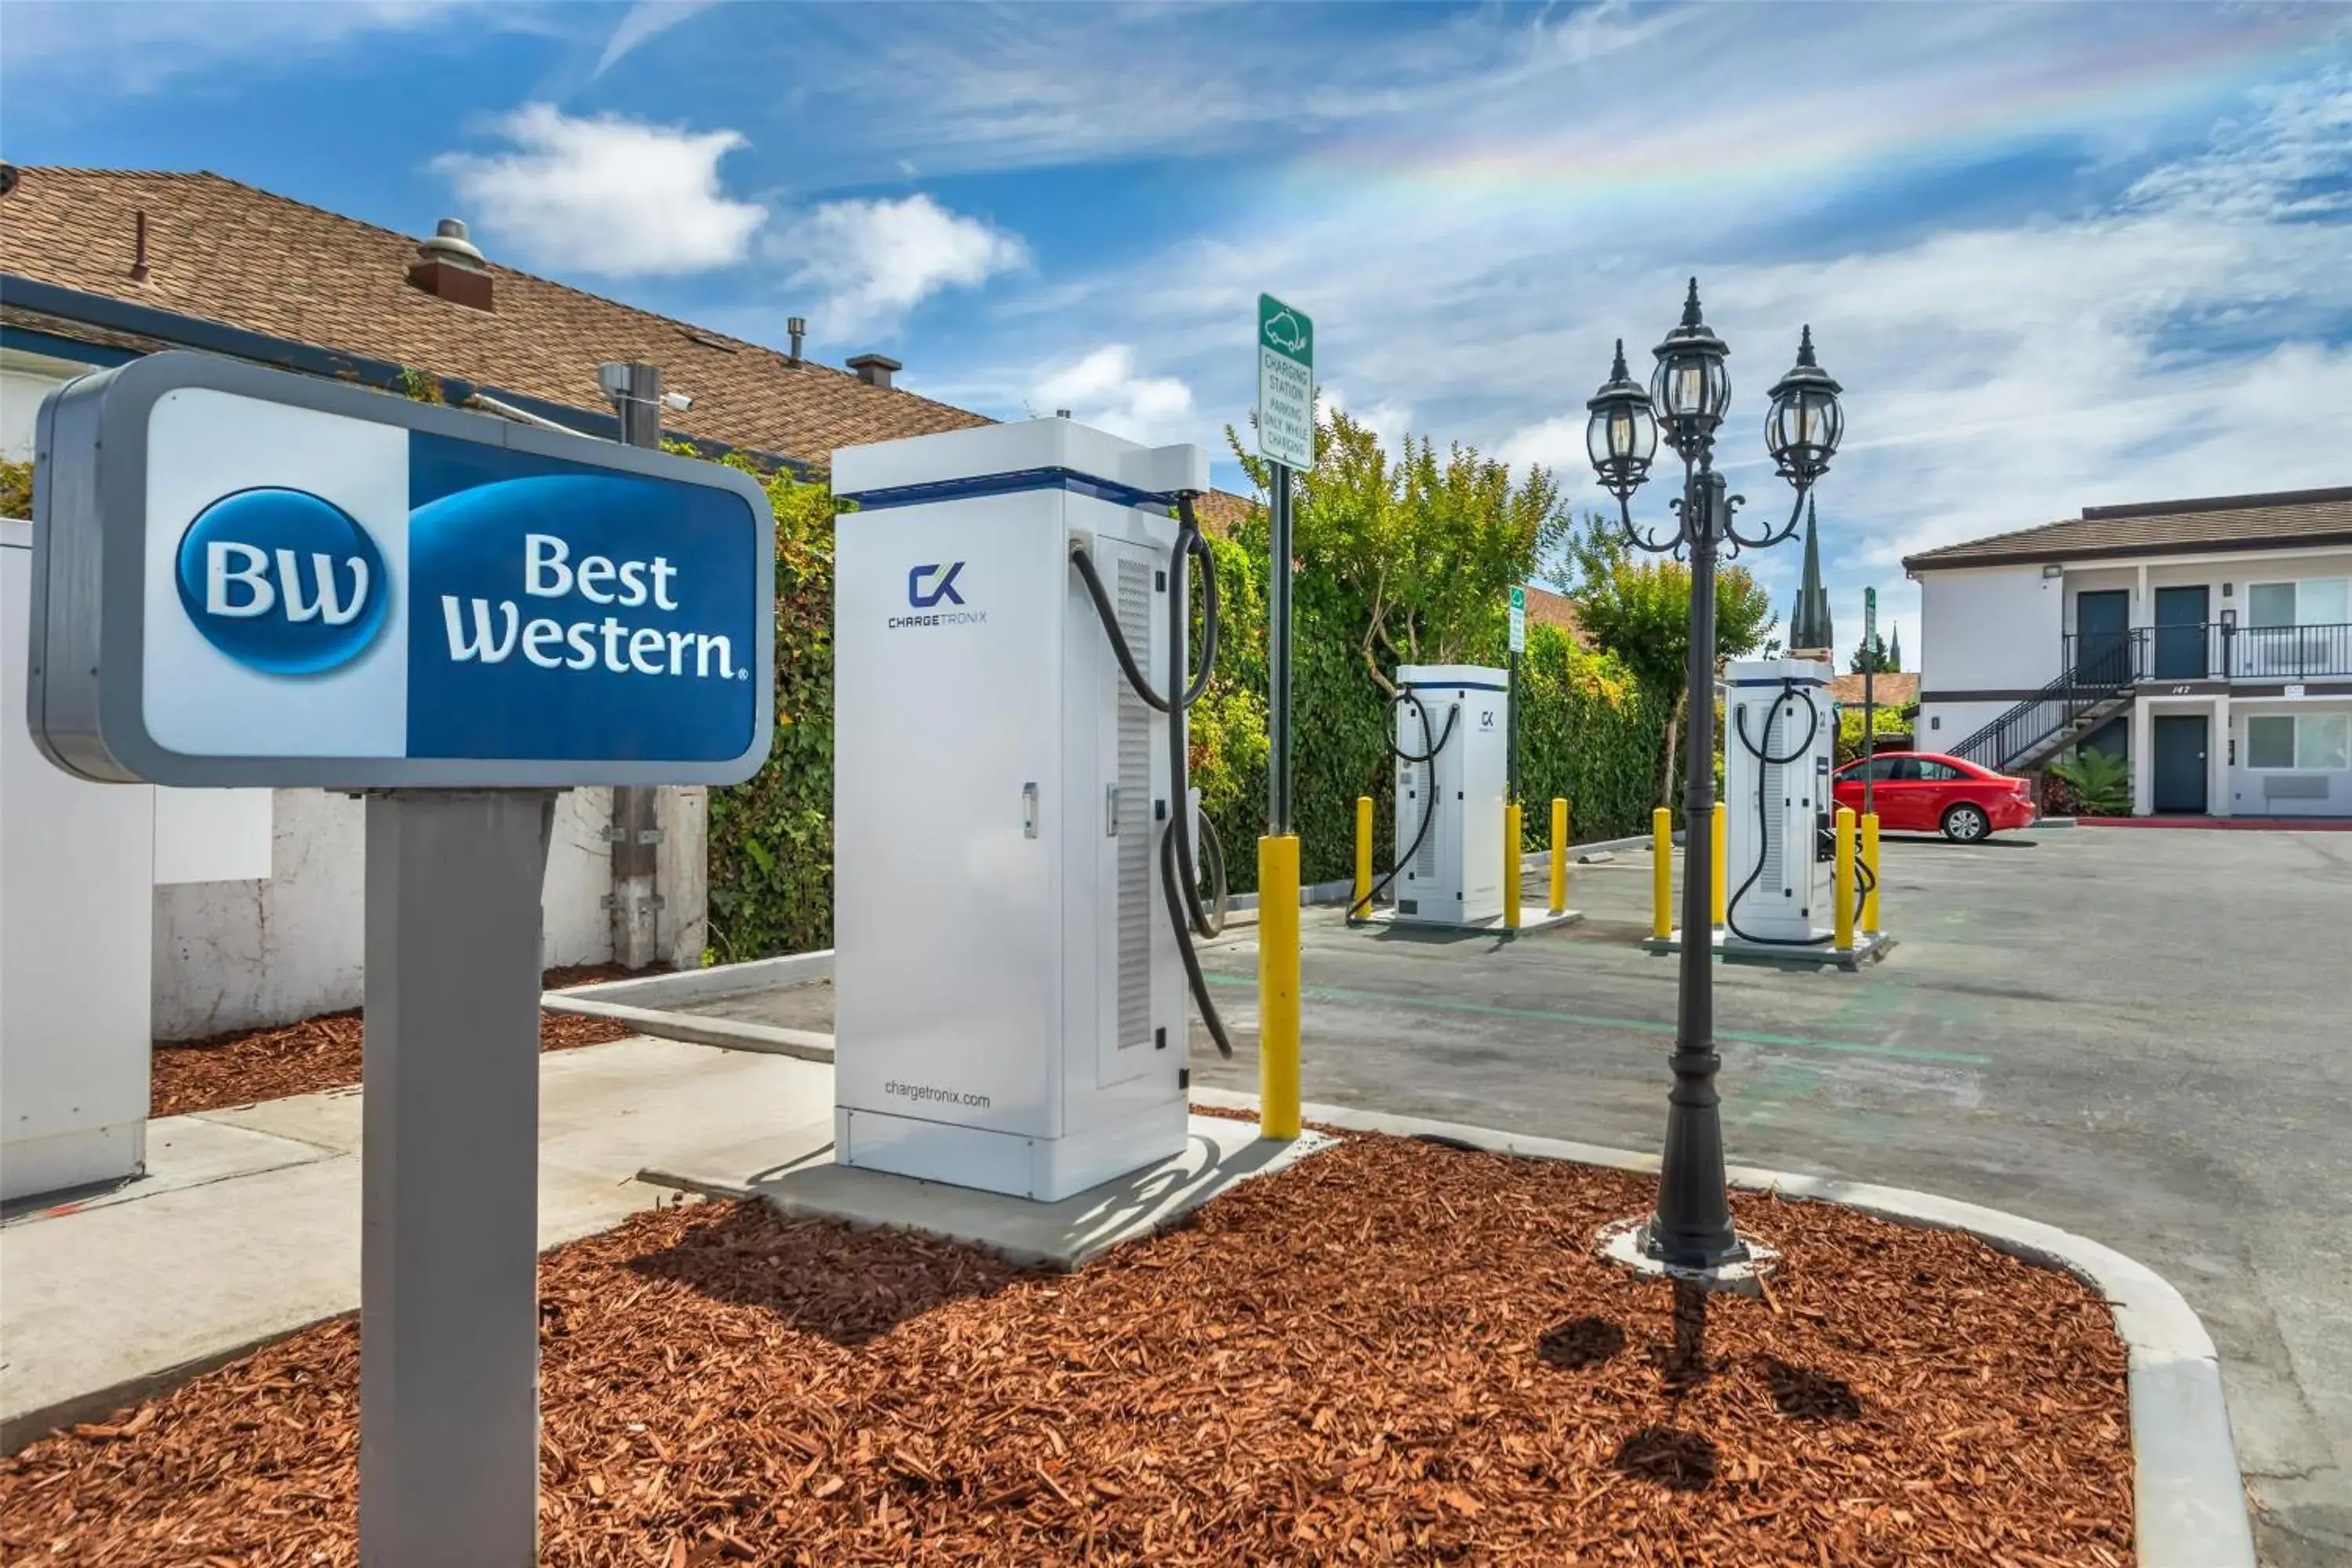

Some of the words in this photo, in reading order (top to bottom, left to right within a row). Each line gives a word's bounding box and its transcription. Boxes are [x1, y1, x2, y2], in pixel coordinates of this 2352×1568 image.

[1265, 354, 1308, 386] CHARGING
[1269, 374, 1304, 401] STATION
[1271, 397, 1301, 421] PARKING
[1264, 412, 1283, 430] ONLY
[1286, 423, 1308, 441] WHILE
[207, 541, 368, 625] BW
[525, 534, 678, 611] Best
[888, 612, 987, 628] CHARGETRONIX
[885, 1080, 990, 1108] chargetronix.com
